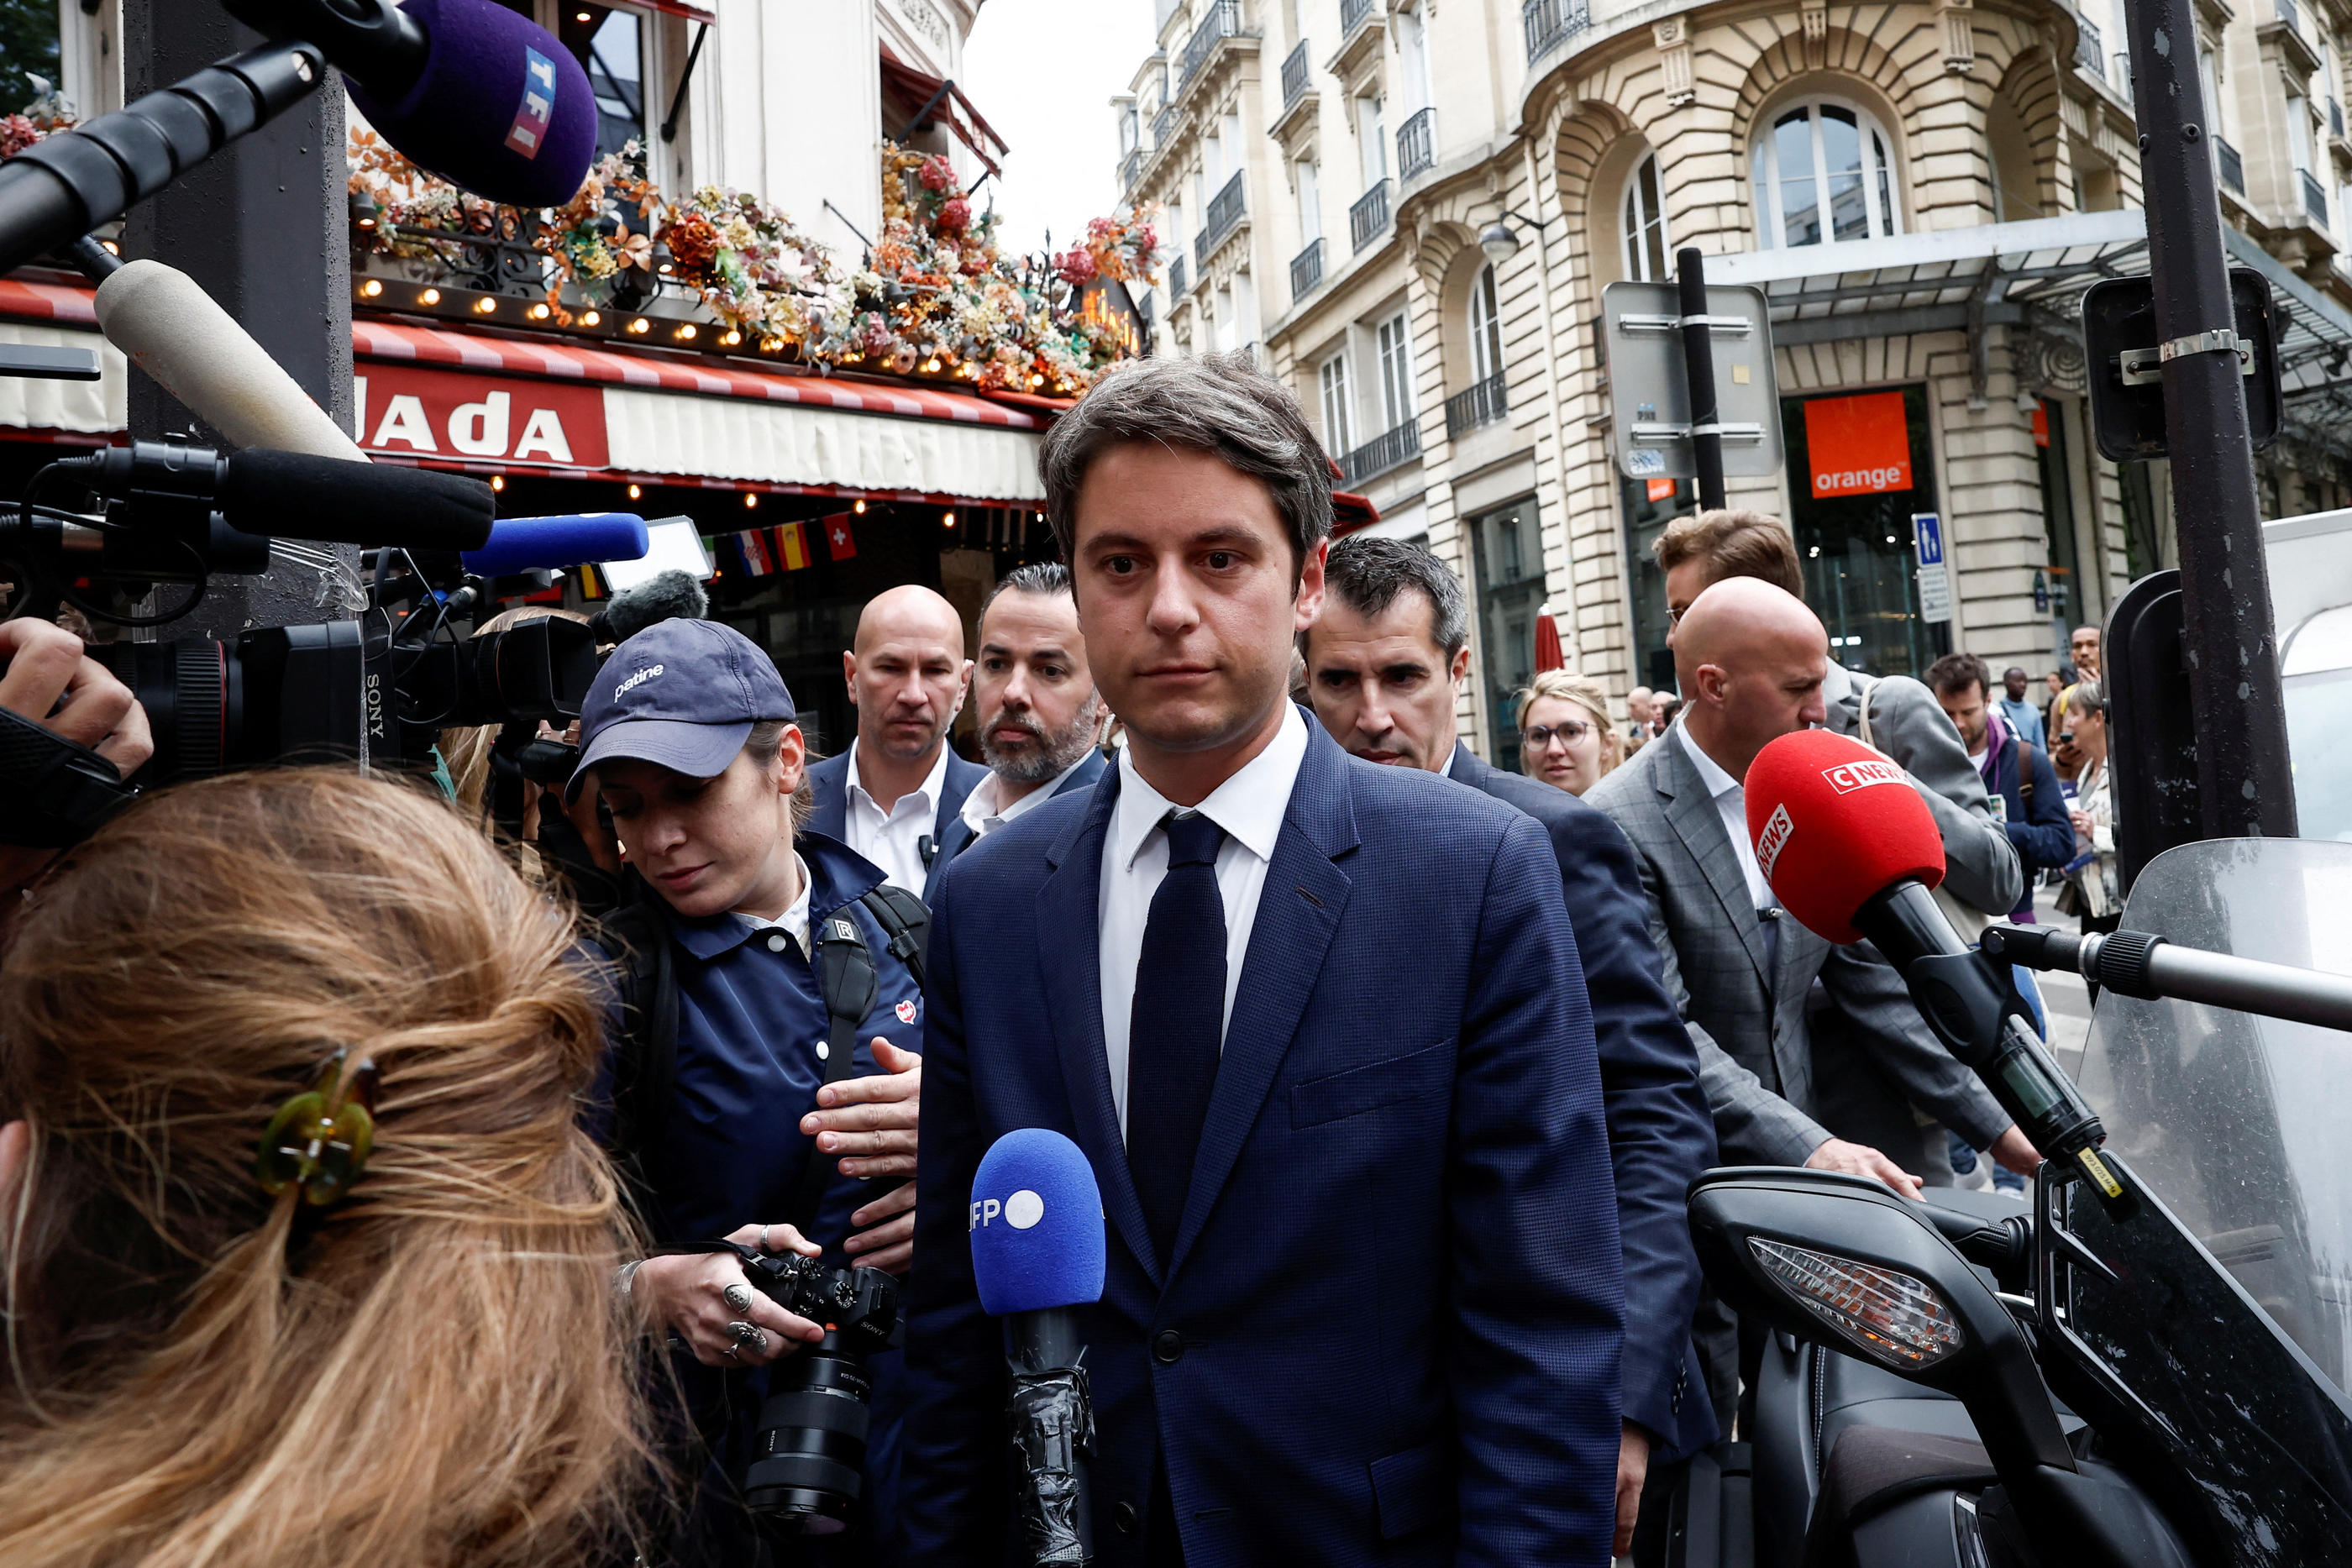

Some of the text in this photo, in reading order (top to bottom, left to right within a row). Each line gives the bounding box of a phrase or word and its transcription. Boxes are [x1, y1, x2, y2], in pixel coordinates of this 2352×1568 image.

[513, 60, 552, 149] TF1
[1816, 467, 1901, 490] orange
[614, 664, 664, 704] patine
[367, 674, 384, 739] SONY
[861, 1321, 885, 1336] SONY
